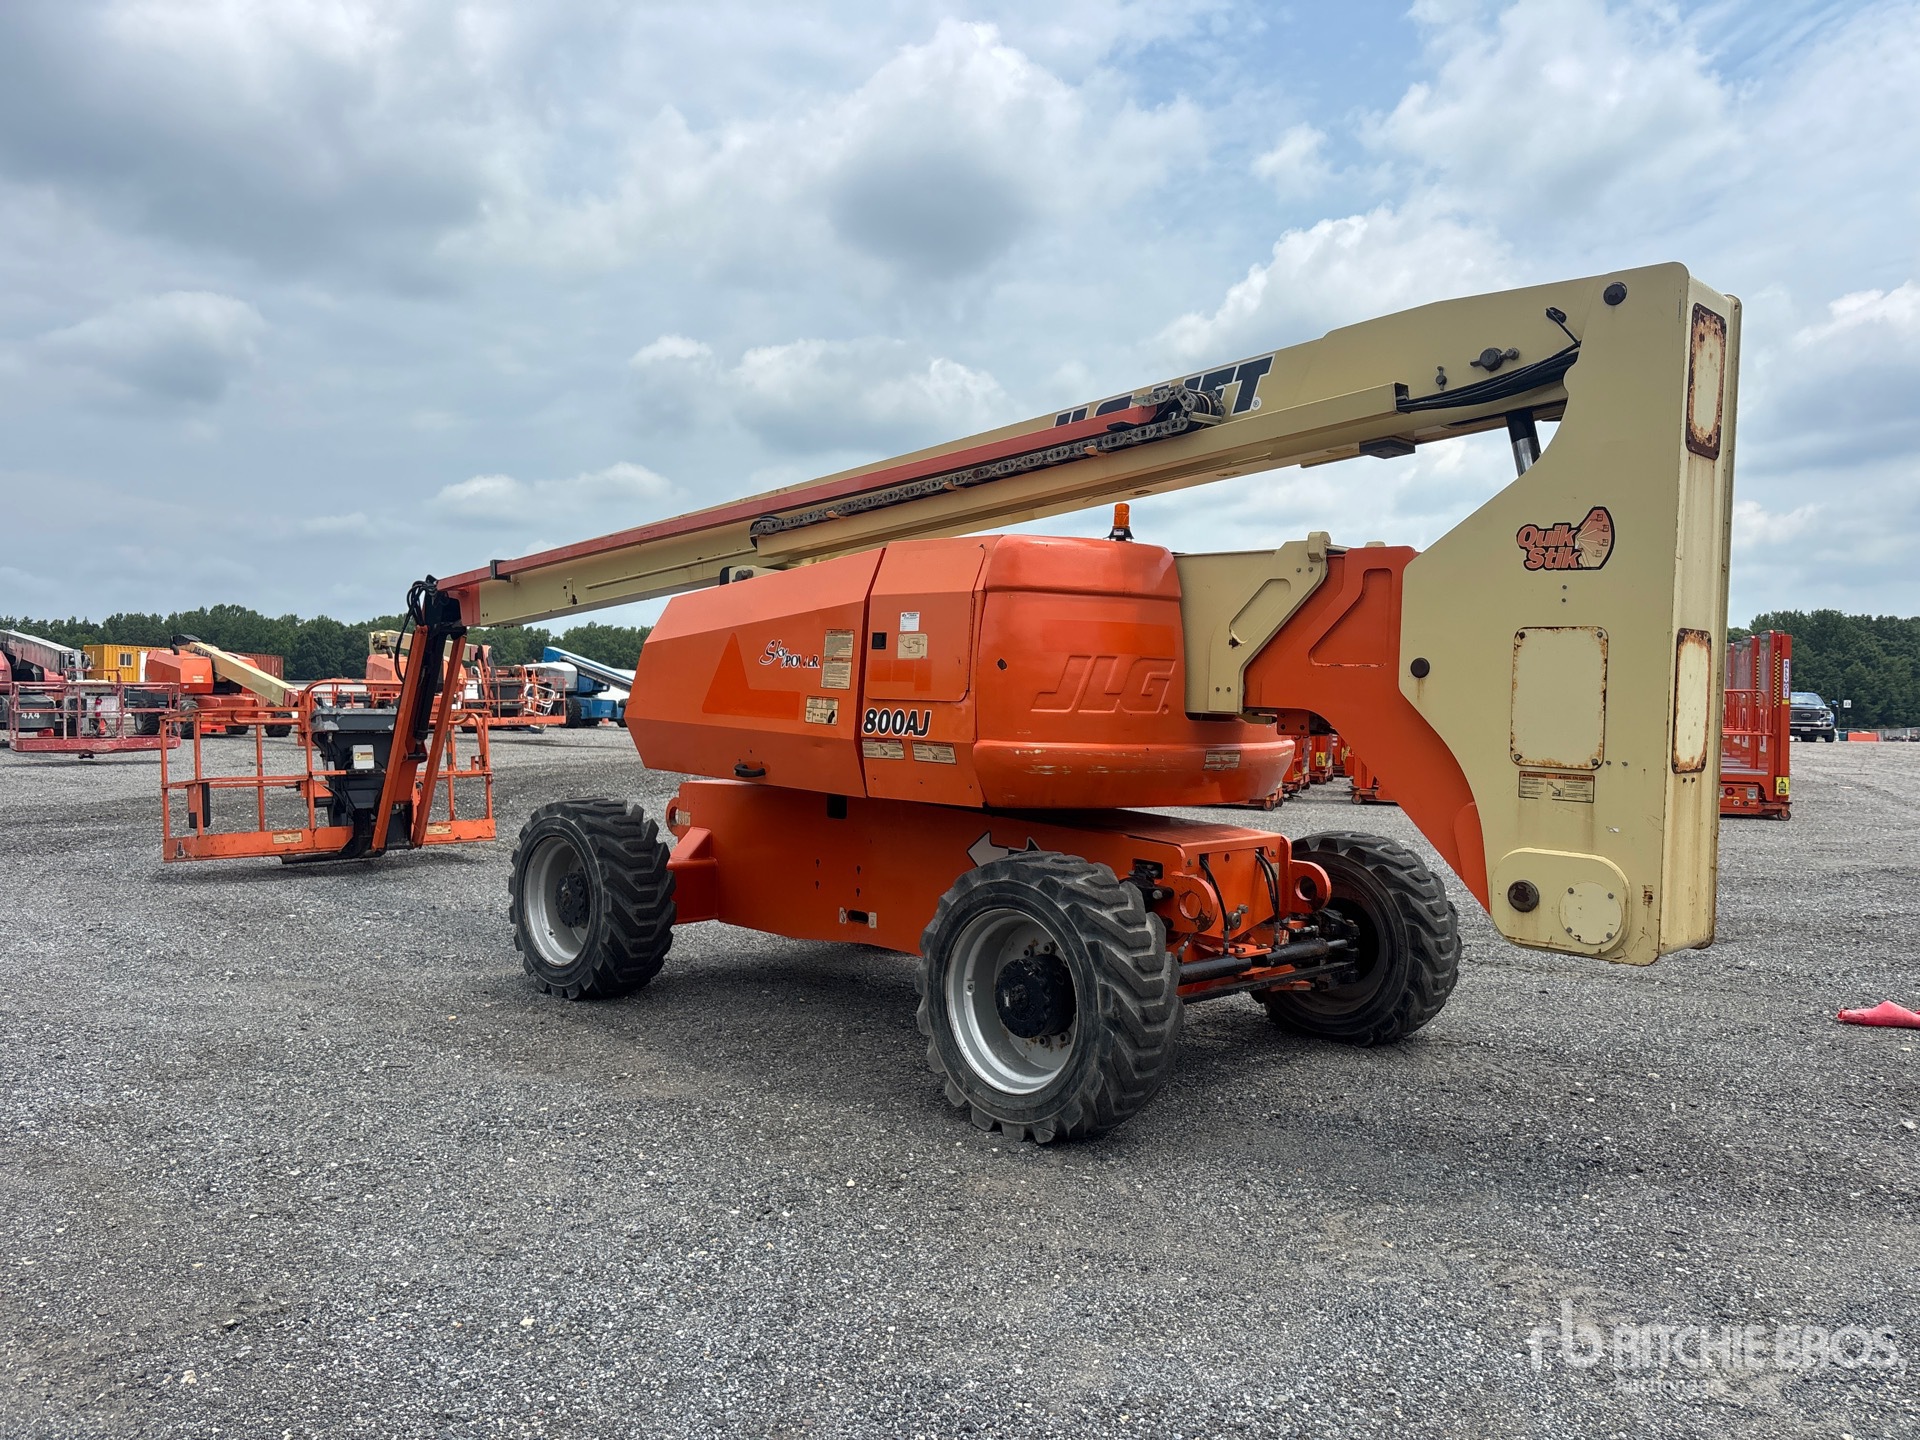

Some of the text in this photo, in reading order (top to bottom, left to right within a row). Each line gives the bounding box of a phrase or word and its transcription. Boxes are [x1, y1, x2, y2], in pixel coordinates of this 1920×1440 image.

[1515, 522, 1577, 549] Quik
[1522, 546, 1580, 569] Stik
[759, 639, 787, 666] Sky
[1030, 654, 1176, 714] JLG
[862, 707, 933, 738] 800AJ
